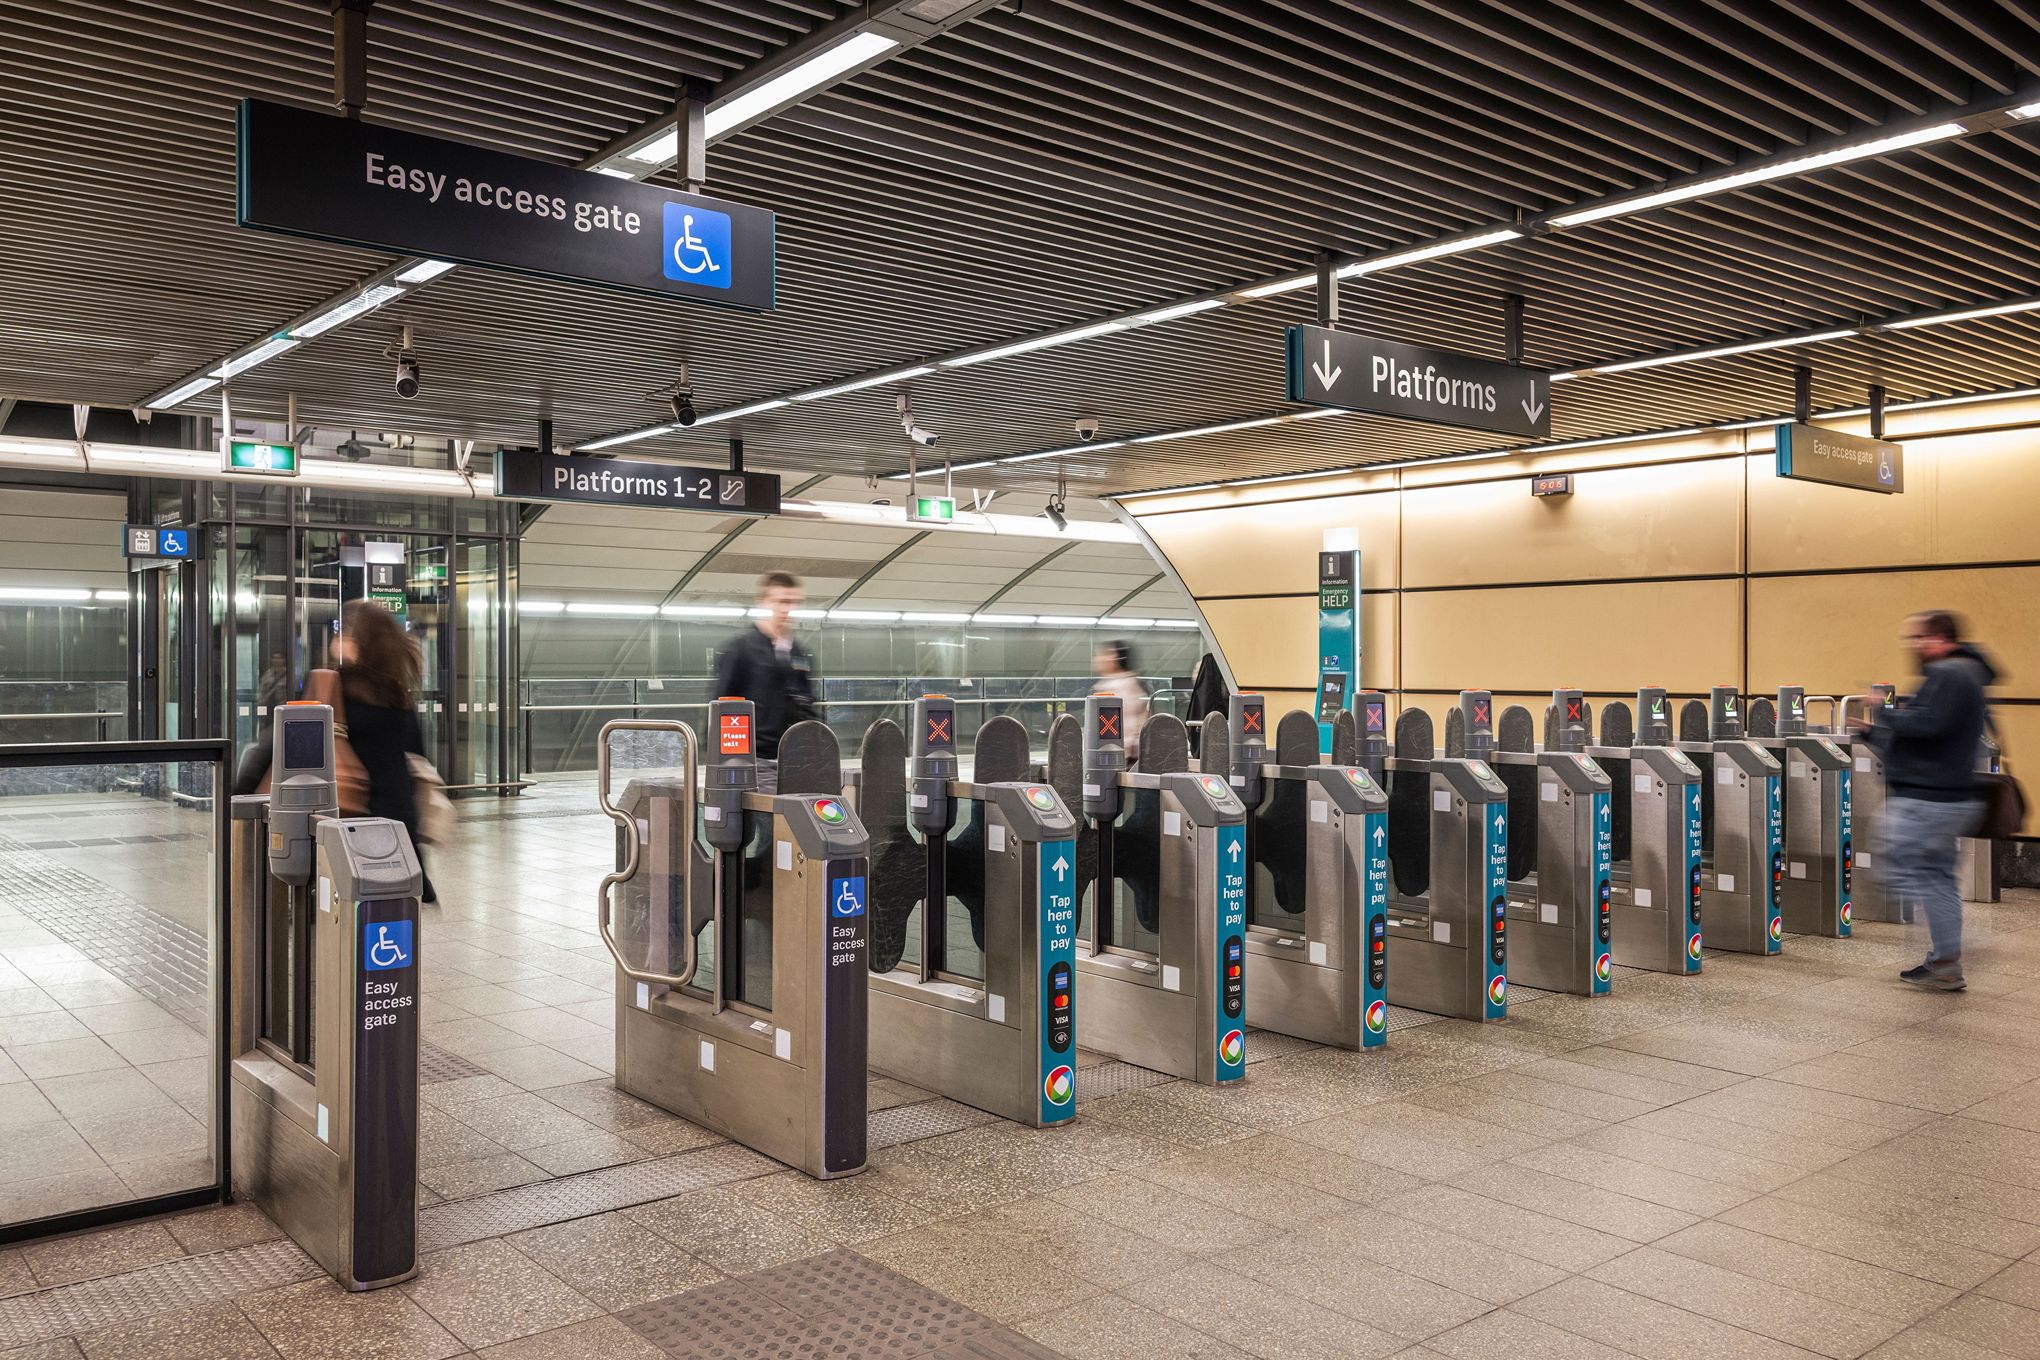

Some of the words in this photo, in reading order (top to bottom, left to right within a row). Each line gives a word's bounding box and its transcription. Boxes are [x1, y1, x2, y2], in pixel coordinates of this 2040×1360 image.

[366, 152, 447, 204] Easy
[454, 176, 567, 221] access
[573, 201, 641, 235] gate
[1372, 355, 1497, 412] Platforms
[1813, 439, 1831, 460] Easy
[1831, 445, 1857, 461] access
[1857, 450, 1873, 465] gate
[554, 466, 668, 498] Platforms
[673, 476, 713, 500] 1-2
[372, 594, 403, 602] Emergency
[1322, 588, 1348, 596] Emergency
[1322, 594, 1349, 607] HELP
[1599, 831, 1611, 841] Tap
[1492, 843, 1506, 855] Tap
[1491, 854, 1507, 865] here
[1602, 852, 1609, 860] to
[1371, 857, 1386, 870] Tap
[1369, 869, 1387, 880] here
[1496, 866, 1504, 875] to
[1225, 874, 1243, 887] Tap
[1375, 882, 1384, 891] to
[1493, 877, 1506, 888] pay
[1223, 887, 1244, 899] here
[1371, 893, 1386, 905] pay
[1049, 894, 1071, 909] Tap
[1230, 900, 1240, 911] to
[1047, 908, 1073, 922] here
[1225, 913, 1243, 926] pay
[832, 926, 857, 939] Easy
[1055, 923, 1067, 935] to
[832, 938, 865, 951] access
[1050, 937, 1071, 952] pay
[832, 952, 856, 967] gate
[364, 981, 399, 996] Easy
[1229, 984, 1241, 992] VISA
[364, 995, 413, 1011] access
[364, 1013, 397, 1030] gate
[1054, 1015, 1069, 1025] VISA
